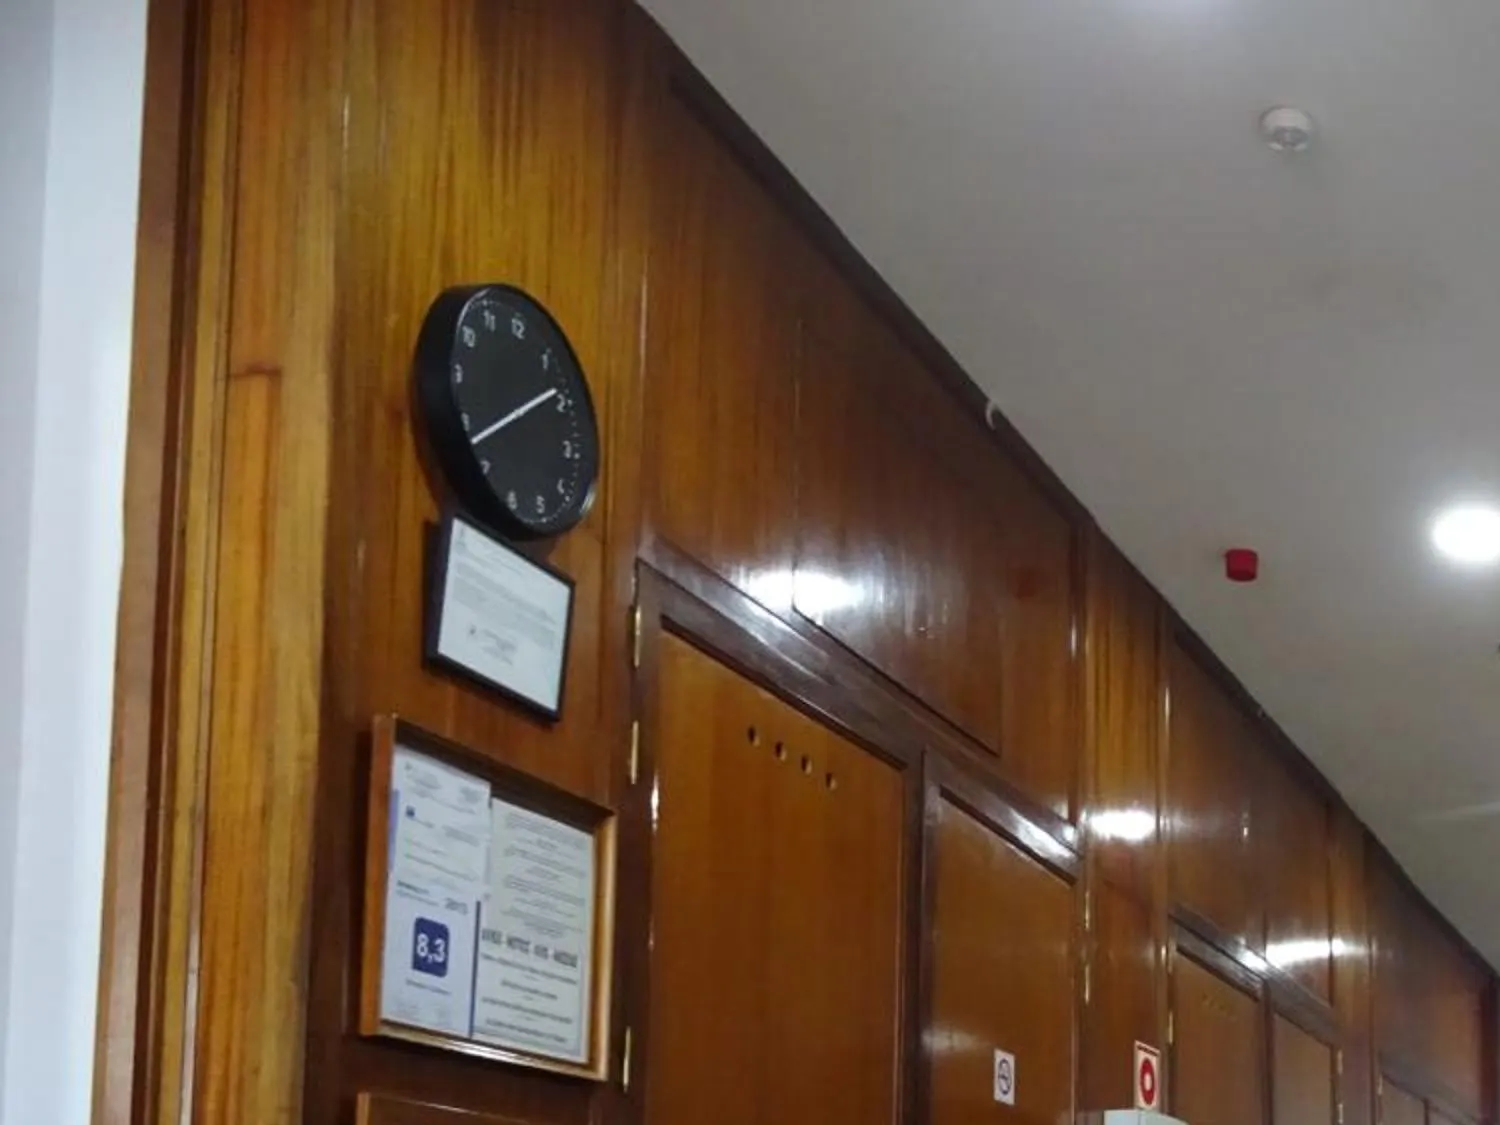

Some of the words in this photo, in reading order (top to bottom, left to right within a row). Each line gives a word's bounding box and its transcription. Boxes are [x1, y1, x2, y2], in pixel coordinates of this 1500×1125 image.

[483, 309, 496, 333] 11
[511, 317, 525, 340] 12
[462, 325, 476, 348] 10
[556, 393, 567, 413] 2
[416, 933, 447, 964] 8,3
